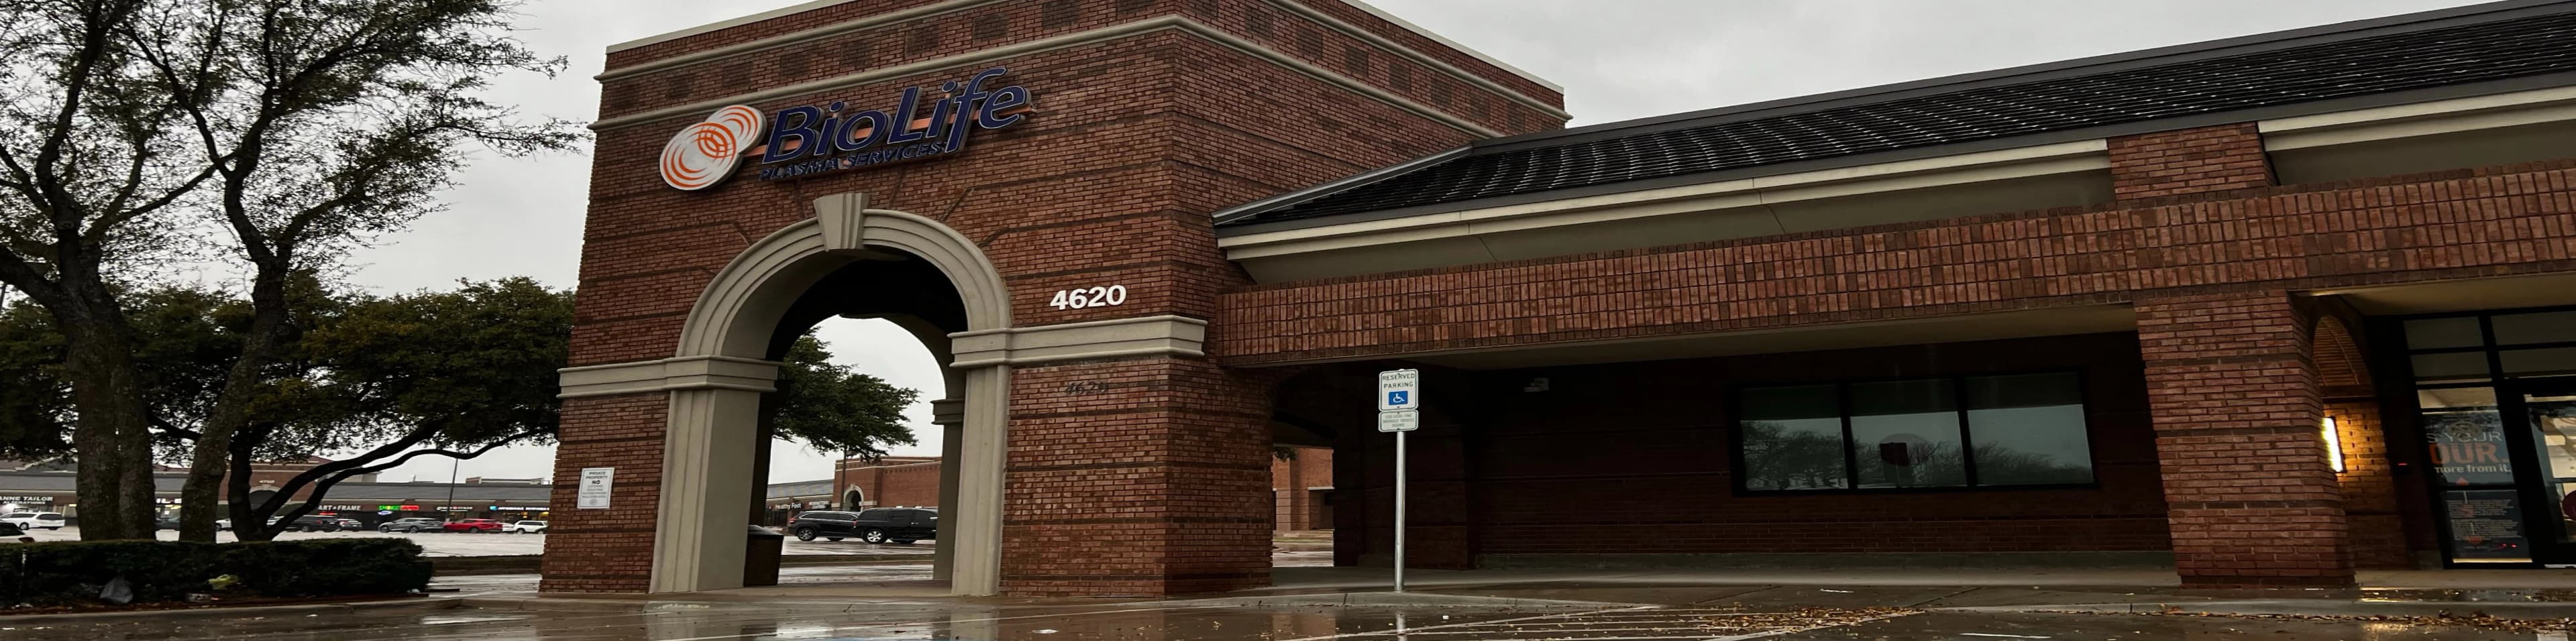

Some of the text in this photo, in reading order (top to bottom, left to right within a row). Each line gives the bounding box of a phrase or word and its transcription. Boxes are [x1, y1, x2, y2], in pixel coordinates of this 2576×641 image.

[761, 67, 1029, 164] BioLife
[759, 141, 945, 182] PLASMA SERVICES
[1050, 285, 1126, 310] 4620
[1382, 373, 1415, 381] RESERVED
[2445, 431, 2502, 443] YOUR
[2467, 464, 2496, 473] from
